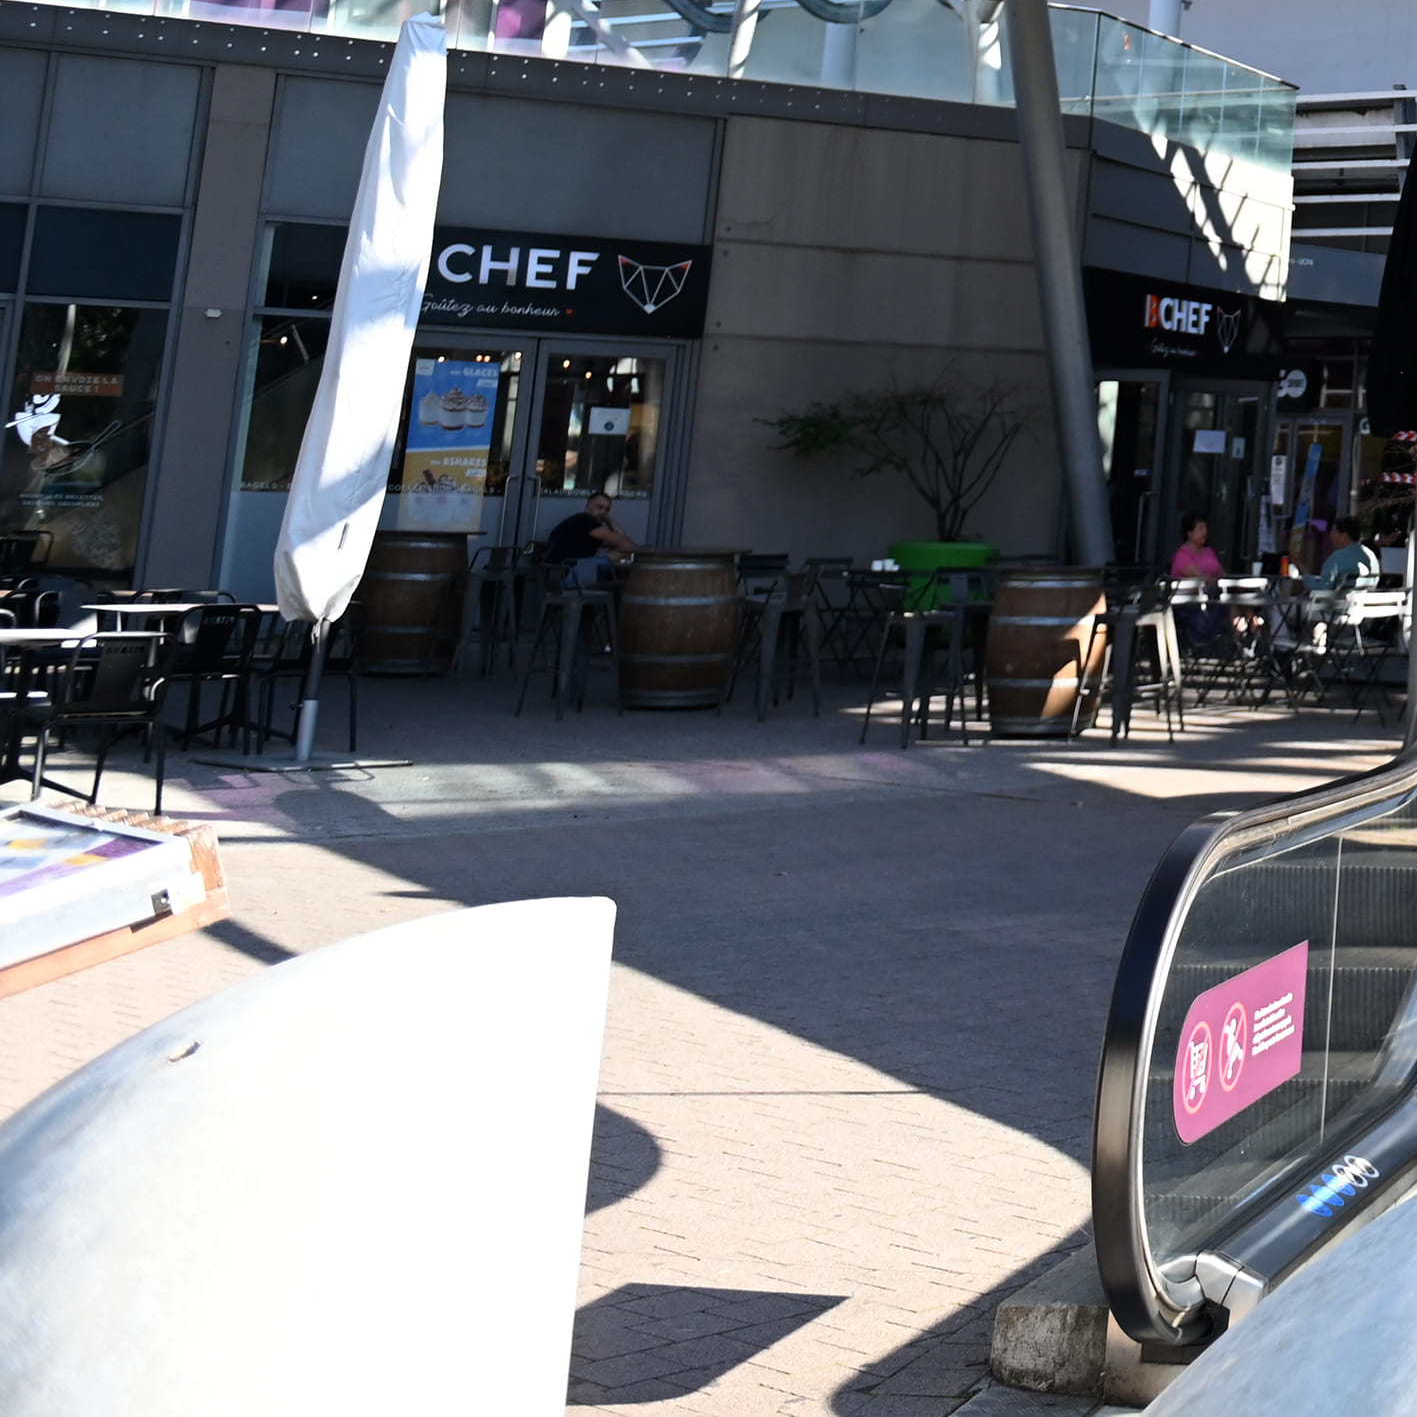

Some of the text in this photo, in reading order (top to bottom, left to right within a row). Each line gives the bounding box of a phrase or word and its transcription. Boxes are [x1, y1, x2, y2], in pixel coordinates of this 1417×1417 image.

[437, 243, 600, 290] CHEF
[477, 303, 497, 314] au
[501, 300, 561, 317] bonheur
